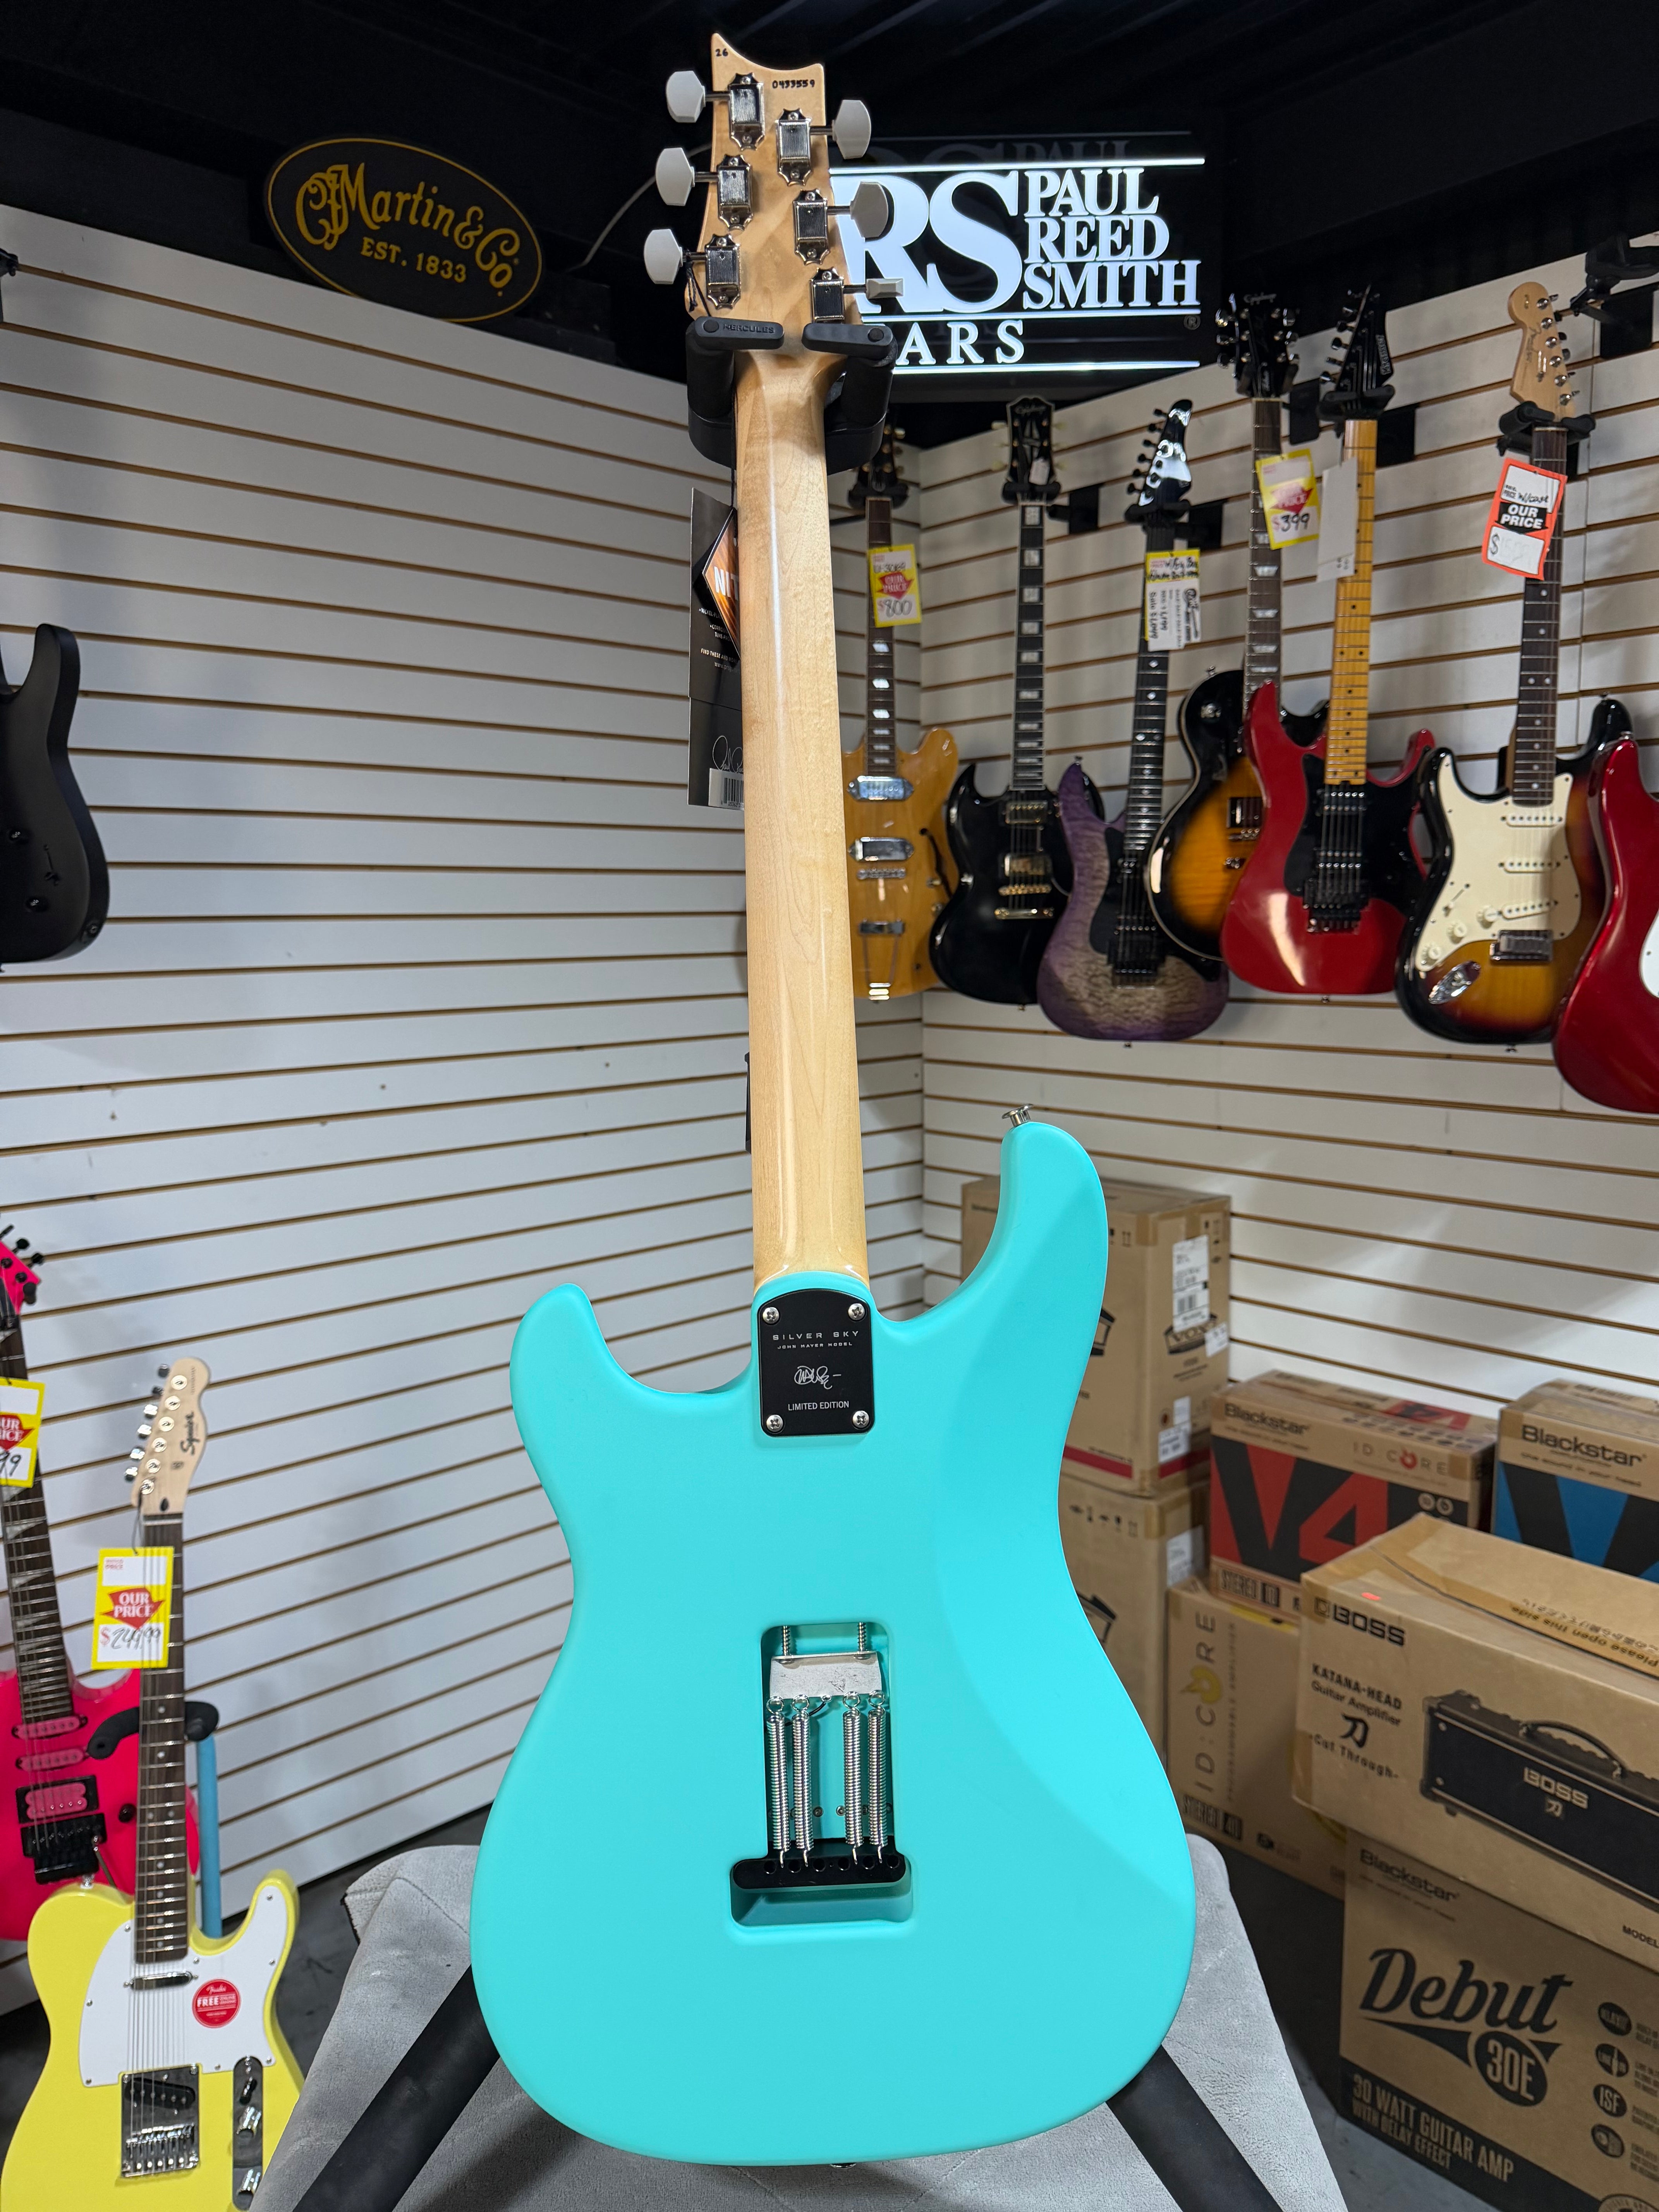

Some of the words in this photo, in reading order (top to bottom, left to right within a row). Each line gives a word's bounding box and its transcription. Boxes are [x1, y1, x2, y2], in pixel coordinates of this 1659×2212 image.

[715, 48, 728, 57] 26
[772, 79, 816, 89] 0433559
[1024, 168, 1159, 218] PAUL
[830, 172, 1023, 313] RS
[1024, 215, 1170, 264] REED
[361, 237, 407, 266] EST.
[416, 252, 467, 283] 1833
[1023, 260, 1202, 310] SMITH
[723, 324, 774, 334] HERCULES
[1500, 514, 1544, 530] PRICE
[1507, 504, 1539, 518] OUR
[714, 566, 739, 601] NIT
[710, 651, 721, 659] THESE
[773, 1332, 823, 1341] SILVER
[788, 1402, 818, 1411] LIMITED
[819, 1400, 850, 1410] EDITION
[1224, 1401, 1311, 1436] Blackstar
[0, 1416, 20, 1430] UR
[1522, 1424, 1643, 1467] Blackstar
[113, 1604, 156, 1618] PRICE
[118, 1592, 149, 1606] OUR
[1511, 1606, 1540, 1621] side
[1333, 1602, 1406, 1647] BOSS
[1543, 1618, 1568, 1633] this
[1572, 1628, 1607, 1646] open
[1311, 1679, 1345, 1702] Guitar
[1348, 1696, 1401, 1726] Amplifier
[1523, 1767, 1589, 1810] BOSS
[1359, 1848, 1459, 1903] Blackstar
[197, 1995, 219, 2008] FREE
[1359, 1947, 1573, 2034] Debut
[1486, 2038, 1536, 2102] 30E
[1599, 2087, 1620, 2113] ISF
[1353, 2073, 1372, 2105] 30
[1375, 2085, 1416, 2131] WATT
[1420, 2111, 1474, 2164] GUITAR
[1477, 2145, 1514, 2183] AMP
[1414, 2133, 1452, 2169] EFFECT
